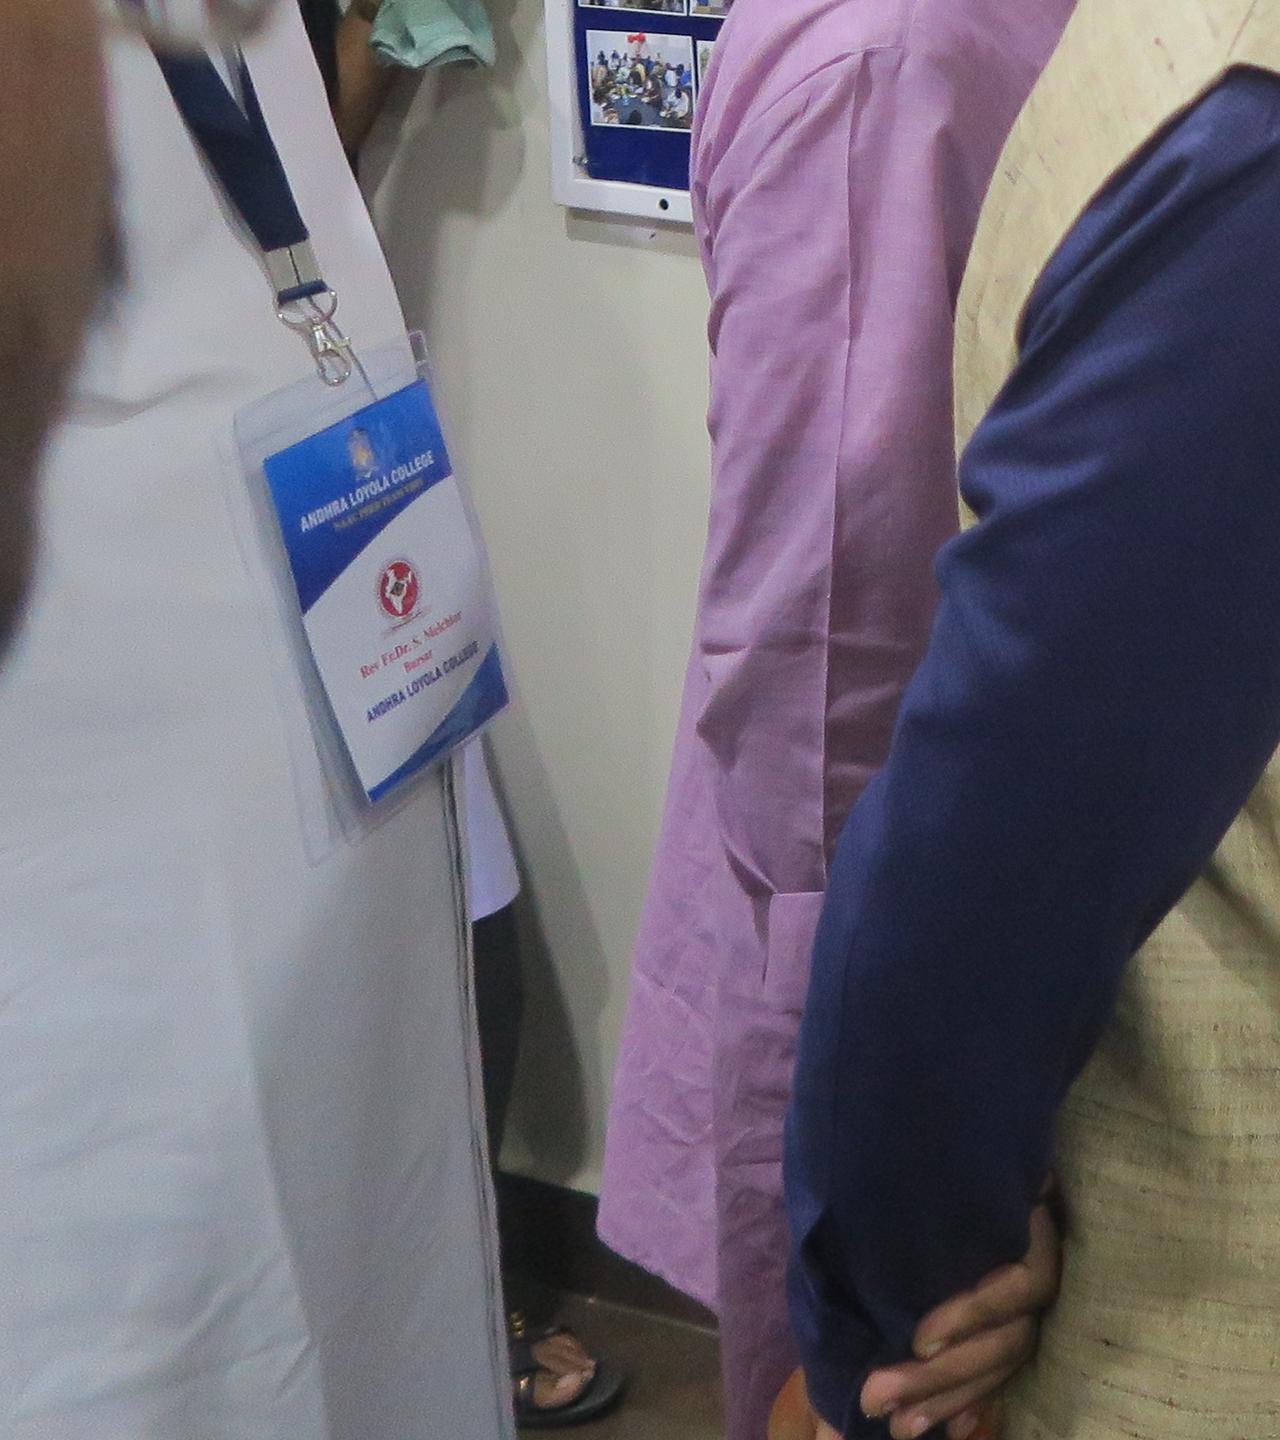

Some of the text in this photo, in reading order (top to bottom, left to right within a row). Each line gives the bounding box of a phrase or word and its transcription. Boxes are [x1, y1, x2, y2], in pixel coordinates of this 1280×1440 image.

[300, 450, 435, 532] ANDHRA LOYOLA COLLEGE
[367, 690, 407, 723] ANDHRA
